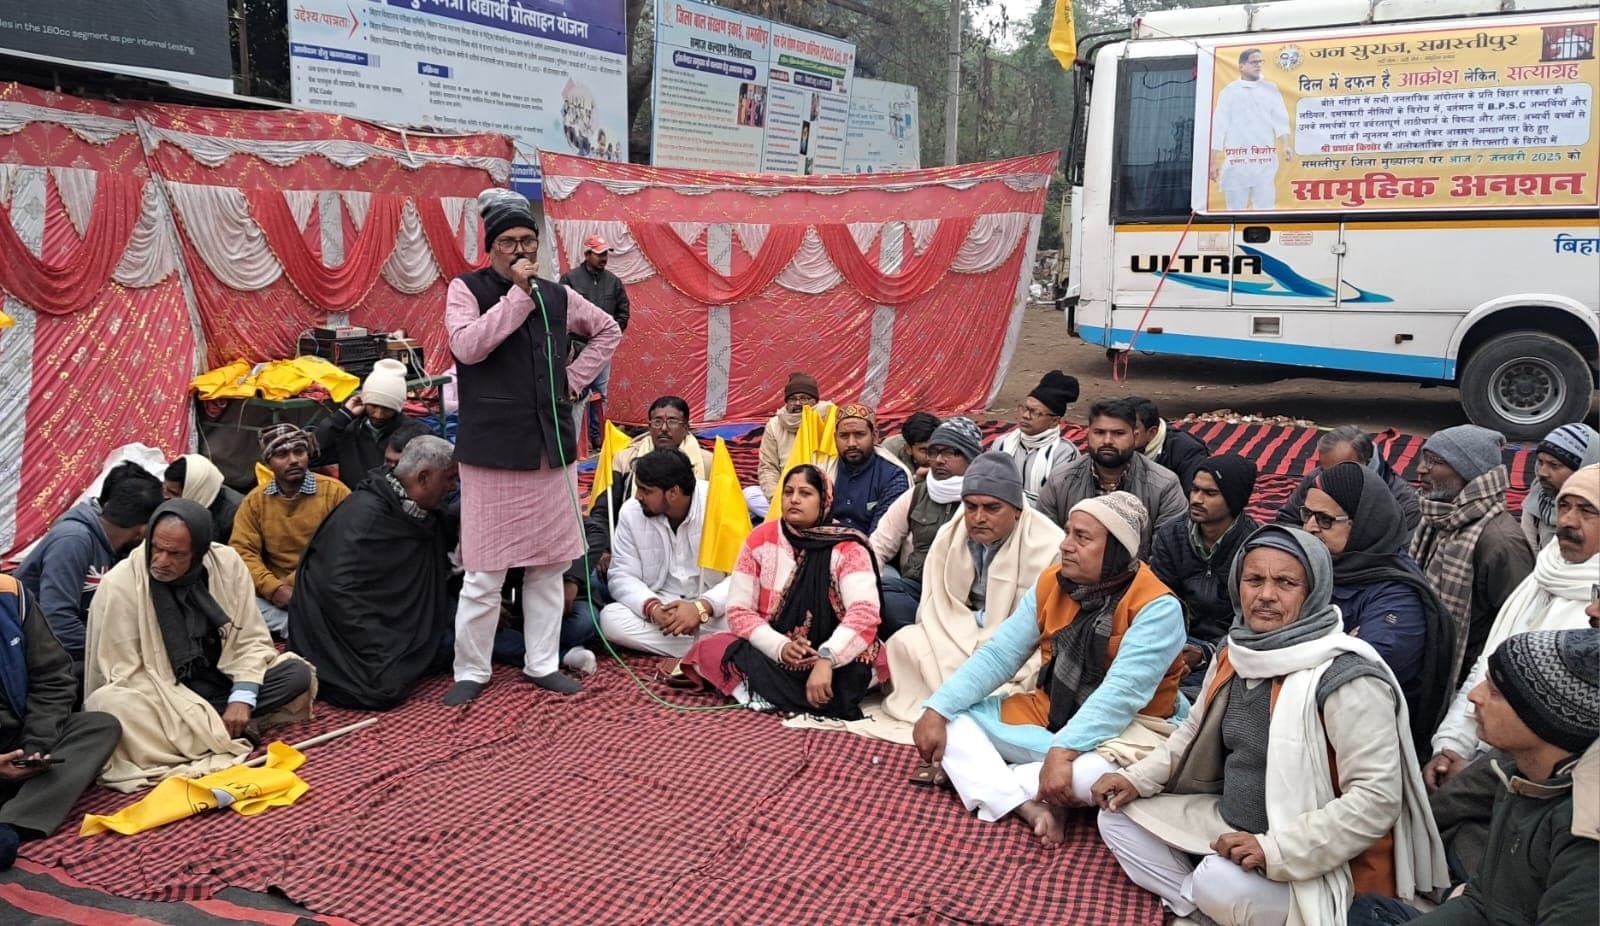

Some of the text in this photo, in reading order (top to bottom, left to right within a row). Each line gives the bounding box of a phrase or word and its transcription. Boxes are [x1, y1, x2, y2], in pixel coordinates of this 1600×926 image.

[510, 1, 555, 32] प्रोत्साहन
[557, 12, 589, 39] योजना
[676, 4, 692, 26] जिला
[694, 13, 706, 29] बाल
[14, 21, 23, 30] in
[24, 22, 41, 32] the
[72, 30, 109, 41] segment
[121, 35, 136, 45] per
[137, 37, 167, 49] internal
[167, 42, 196, 55] testing
[1310, 46, 1346, 59] जन
[1350, 42, 1411, 60] सुराज,
[1417, 33, 1519, 51] समस्तीपुर
[1298, 74, 1323, 91] दिल
[1329, 72, 1340, 90] में
[1381, 69, 1391, 89] है
[1398, 66, 1459, 87] आक्रोश
[1507, 63, 1579, 81] सत्याग्रह
[1468, 90, 1475, 98] के
[1478, 89, 1493, 99] प्रति
[1497, 88, 1519, 98] बिहार
[1522, 88, 1549, 97] सरकार
[1552, 86, 1563, 95] की
[1397, 106, 1404, 114] के
[1488, 102, 1526, 111] B.P.S.C
[1571, 96, 1587, 106] और
[1441, 115, 1448, 123] के
[1479, 112, 1493, 122] और
[1578, 110, 1586, 118] से
[1537, 124, 1549, 134] हुए
[1225, 145, 1277, 155] प्रशांत किशोर
[1356, 142, 1381, 152] किशोर
[1383, 141, 1393, 149] की
[1462, 138, 1469, 147] से
[1512, 137, 1519, 145] के
[1523, 136, 1547, 145] विरोध
[1550, 134, 1558, 144] में
[1302, 149, 1581, 171] समस्तीपुर जिला मुख्यालय पर आज 7 जनवरी 2025 को
[1291, 172, 1587, 207] सामुहिक अनशन
[1130, 254, 1262, 275] ULTRA
